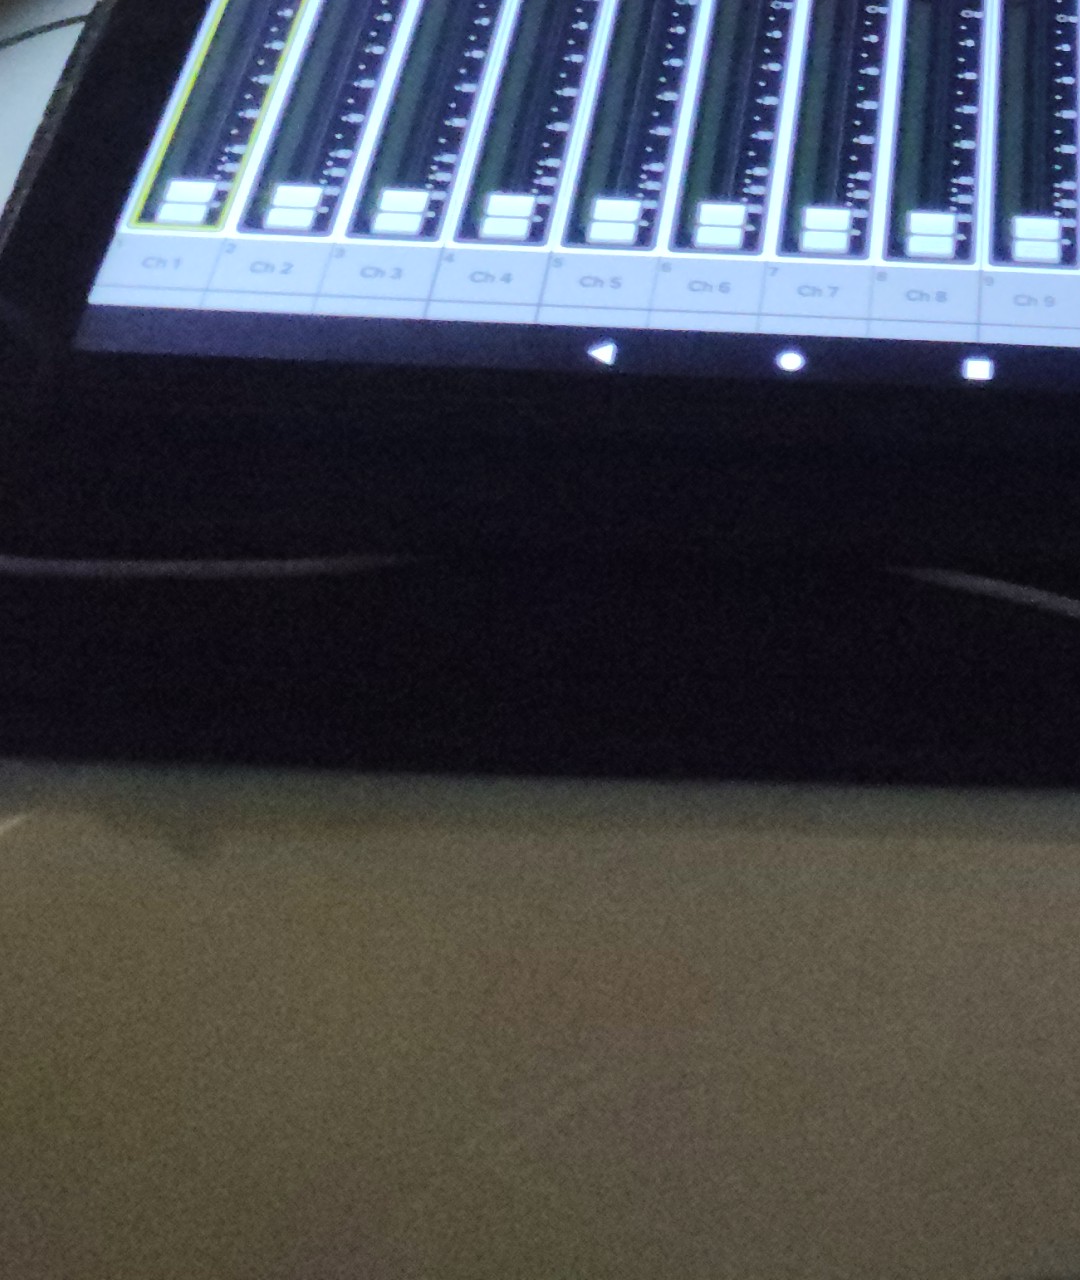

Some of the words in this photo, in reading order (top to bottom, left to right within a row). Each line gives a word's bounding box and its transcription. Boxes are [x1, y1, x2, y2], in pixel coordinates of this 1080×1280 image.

[141, 256, 168, 270] Ch
[172, 258, 182, 271] 1
[249, 260, 275, 274] Ch
[280, 262, 295, 275] 2
[360, 265, 386, 279] Ch
[391, 267, 404, 280] 3
[469, 270, 496, 284] Ch
[499, 272, 513, 285] 4
[579, 275, 604, 289] Ch
[609, 276, 623, 290] 5
[687, 279, 714, 293] Ch
[718, 281, 731, 294] 6
[797, 284, 823, 298] Ch
[826, 285, 840, 298] 7
[905, 289, 931, 302] Ch
[935, 291, 948, 303] 8
[1013, 293, 1038, 307] Ch
[1043, 295, 1056, 308] 9
